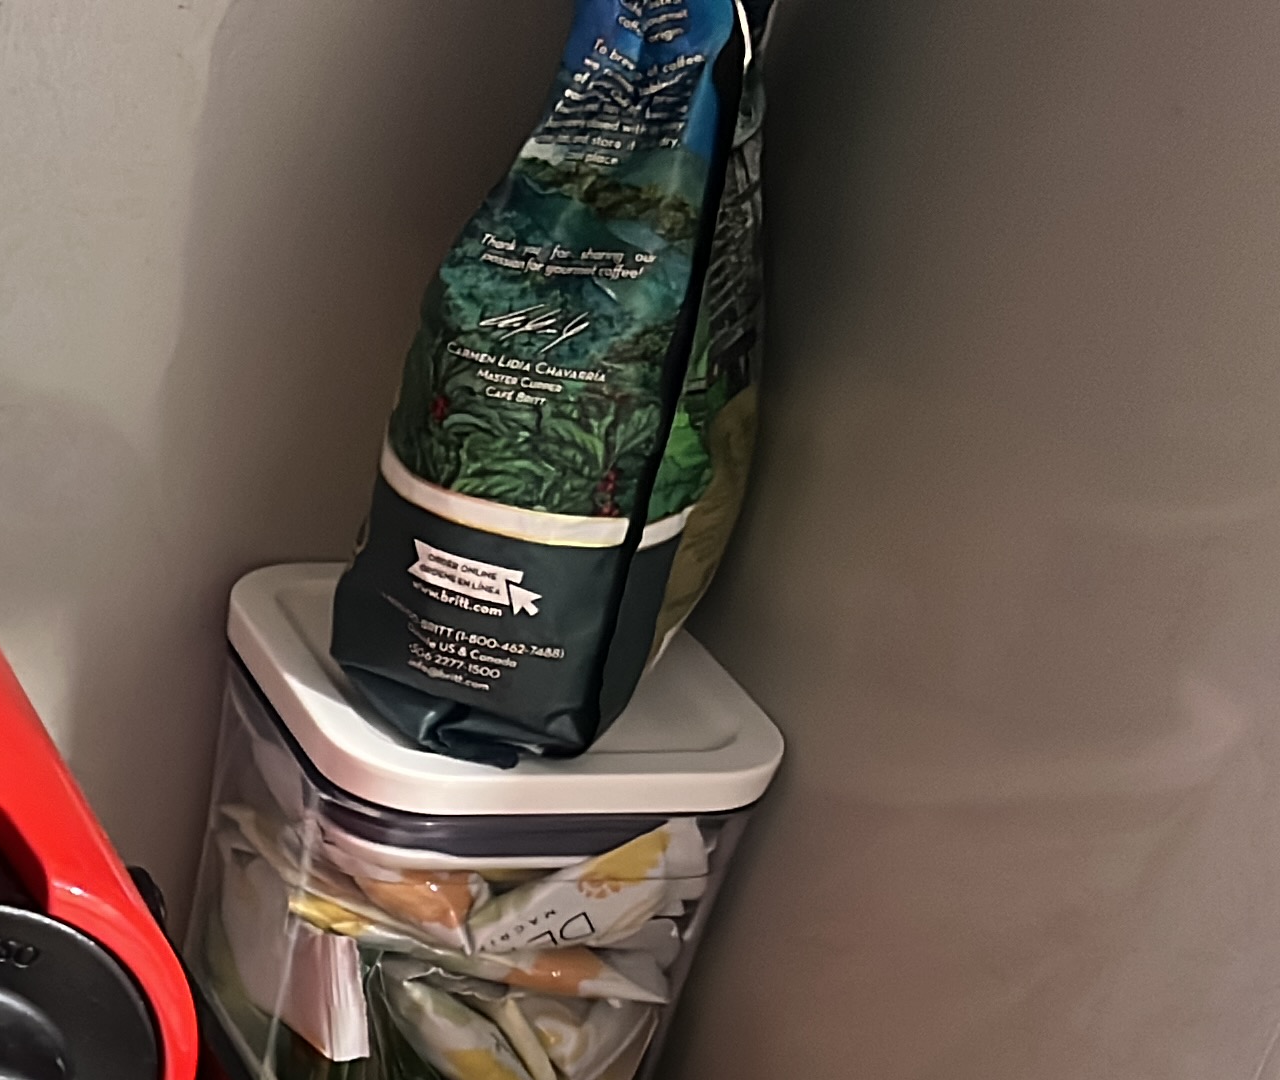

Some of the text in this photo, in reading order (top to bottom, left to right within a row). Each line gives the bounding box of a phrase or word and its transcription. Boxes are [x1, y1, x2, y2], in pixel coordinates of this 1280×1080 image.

[634, 253, 658, 264] our
[460, 564, 498, 581] ONLINE
[412, 580, 503, 617] www.britt.com
[438, 641, 456, 655] US
[456, 645, 468, 657] &
